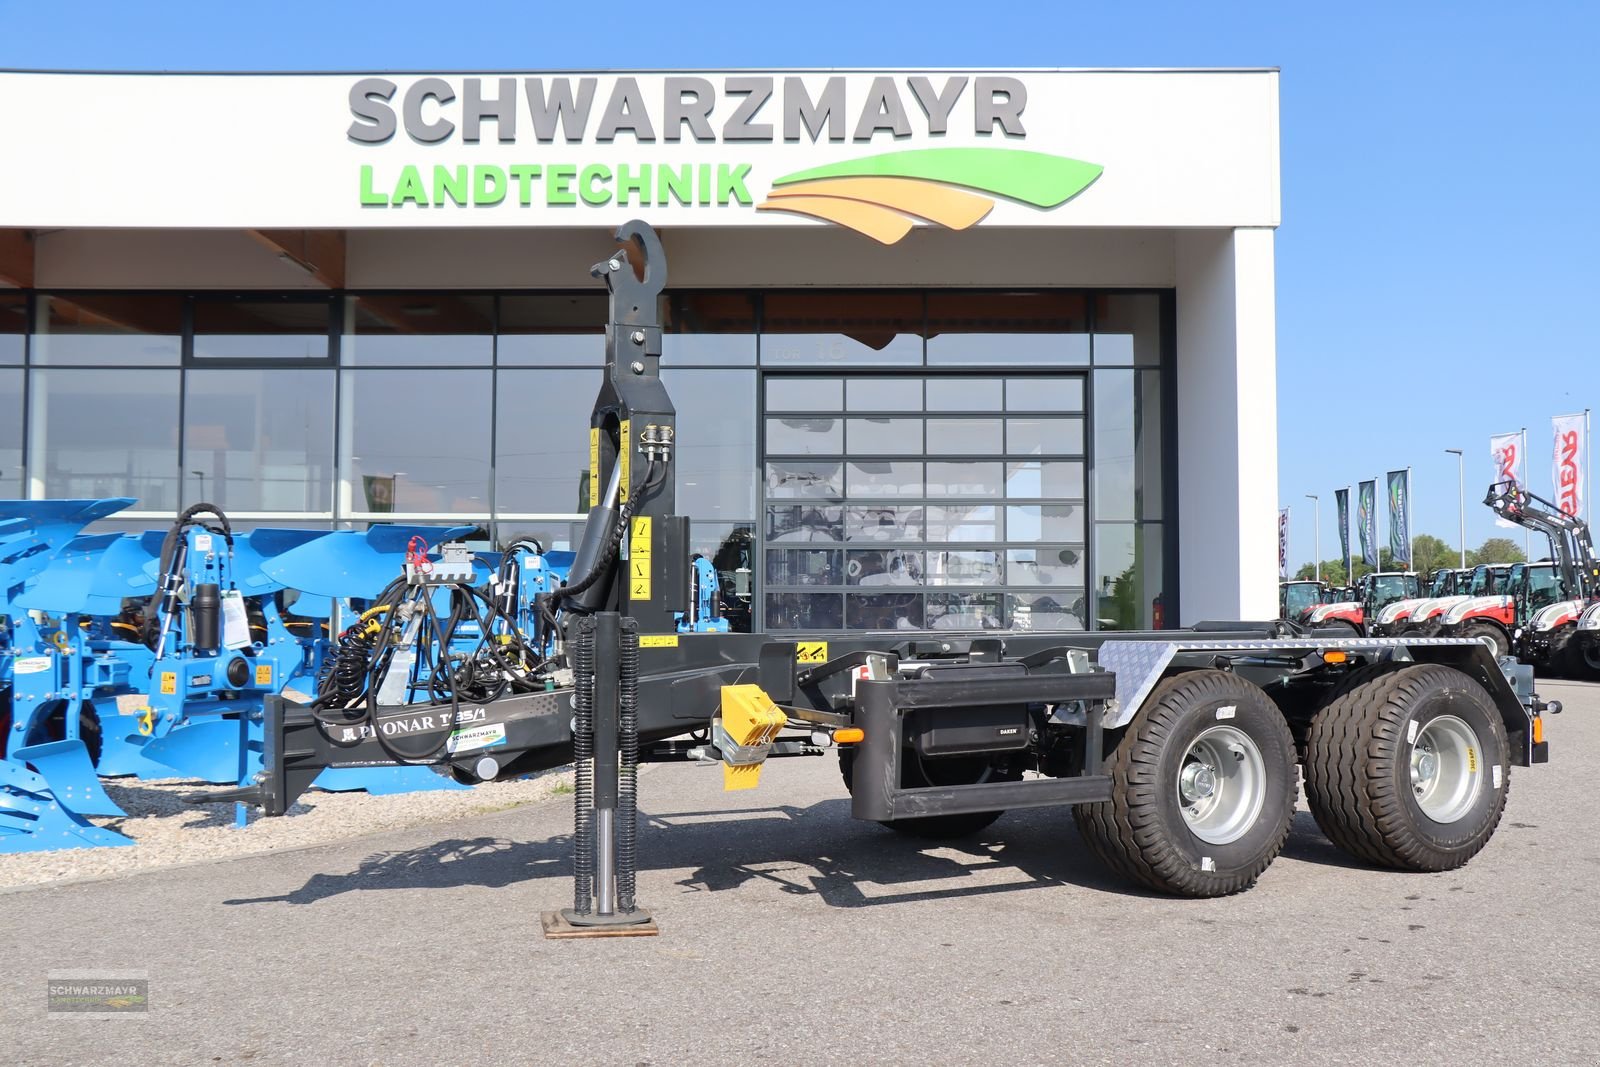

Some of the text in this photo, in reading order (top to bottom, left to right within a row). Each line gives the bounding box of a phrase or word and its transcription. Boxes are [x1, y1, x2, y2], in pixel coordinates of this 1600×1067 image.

[347, 77, 1027, 144] SCHWARZMAYR
[360, 164, 753, 207] LANDTECHNIK
[452, 729, 497, 741] SCHWARZMAYR
